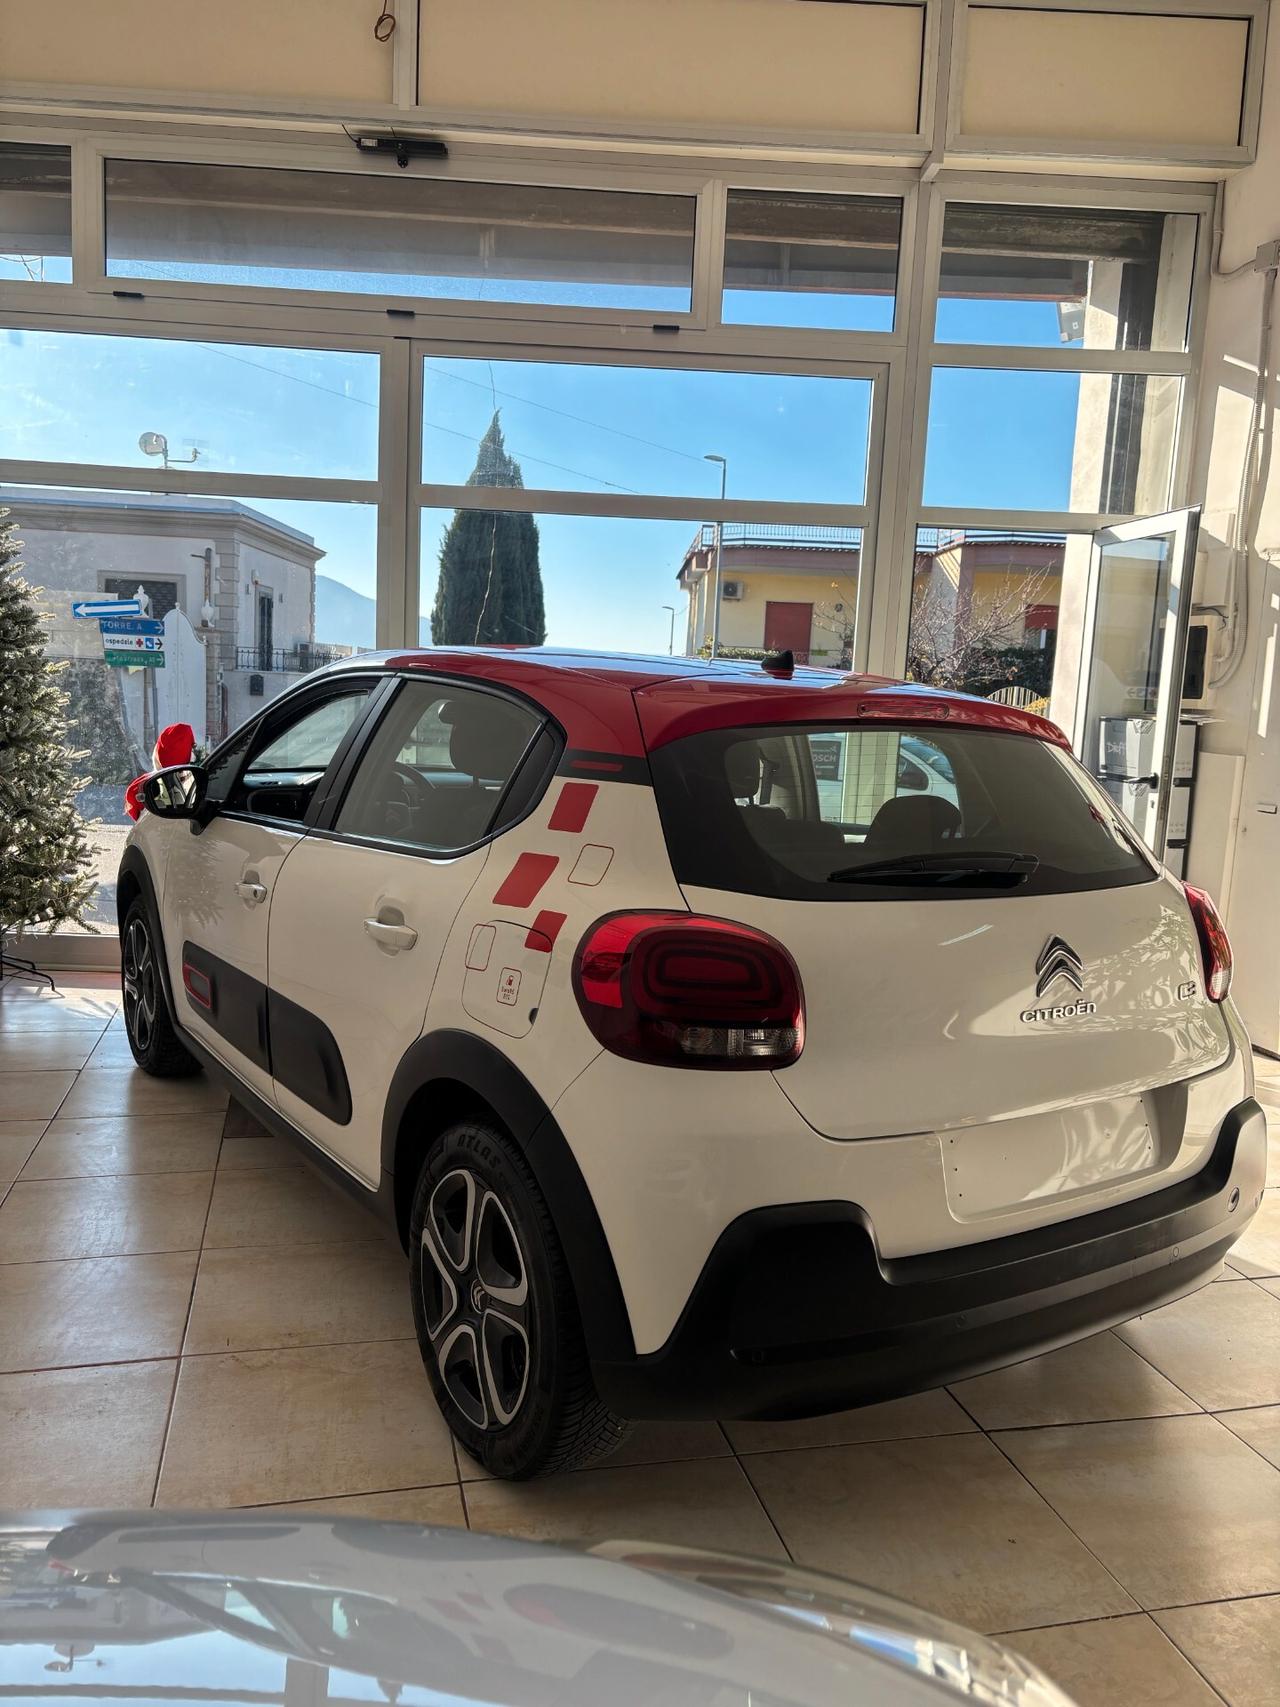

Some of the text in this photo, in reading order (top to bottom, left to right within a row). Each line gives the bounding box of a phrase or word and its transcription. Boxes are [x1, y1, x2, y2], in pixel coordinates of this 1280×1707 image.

[103, 620, 132, 630] TORRE
[105, 637, 133, 646] ospedale
[812, 753, 837, 763] OSCH
[456, 1134, 502, 1169] ATLAS
